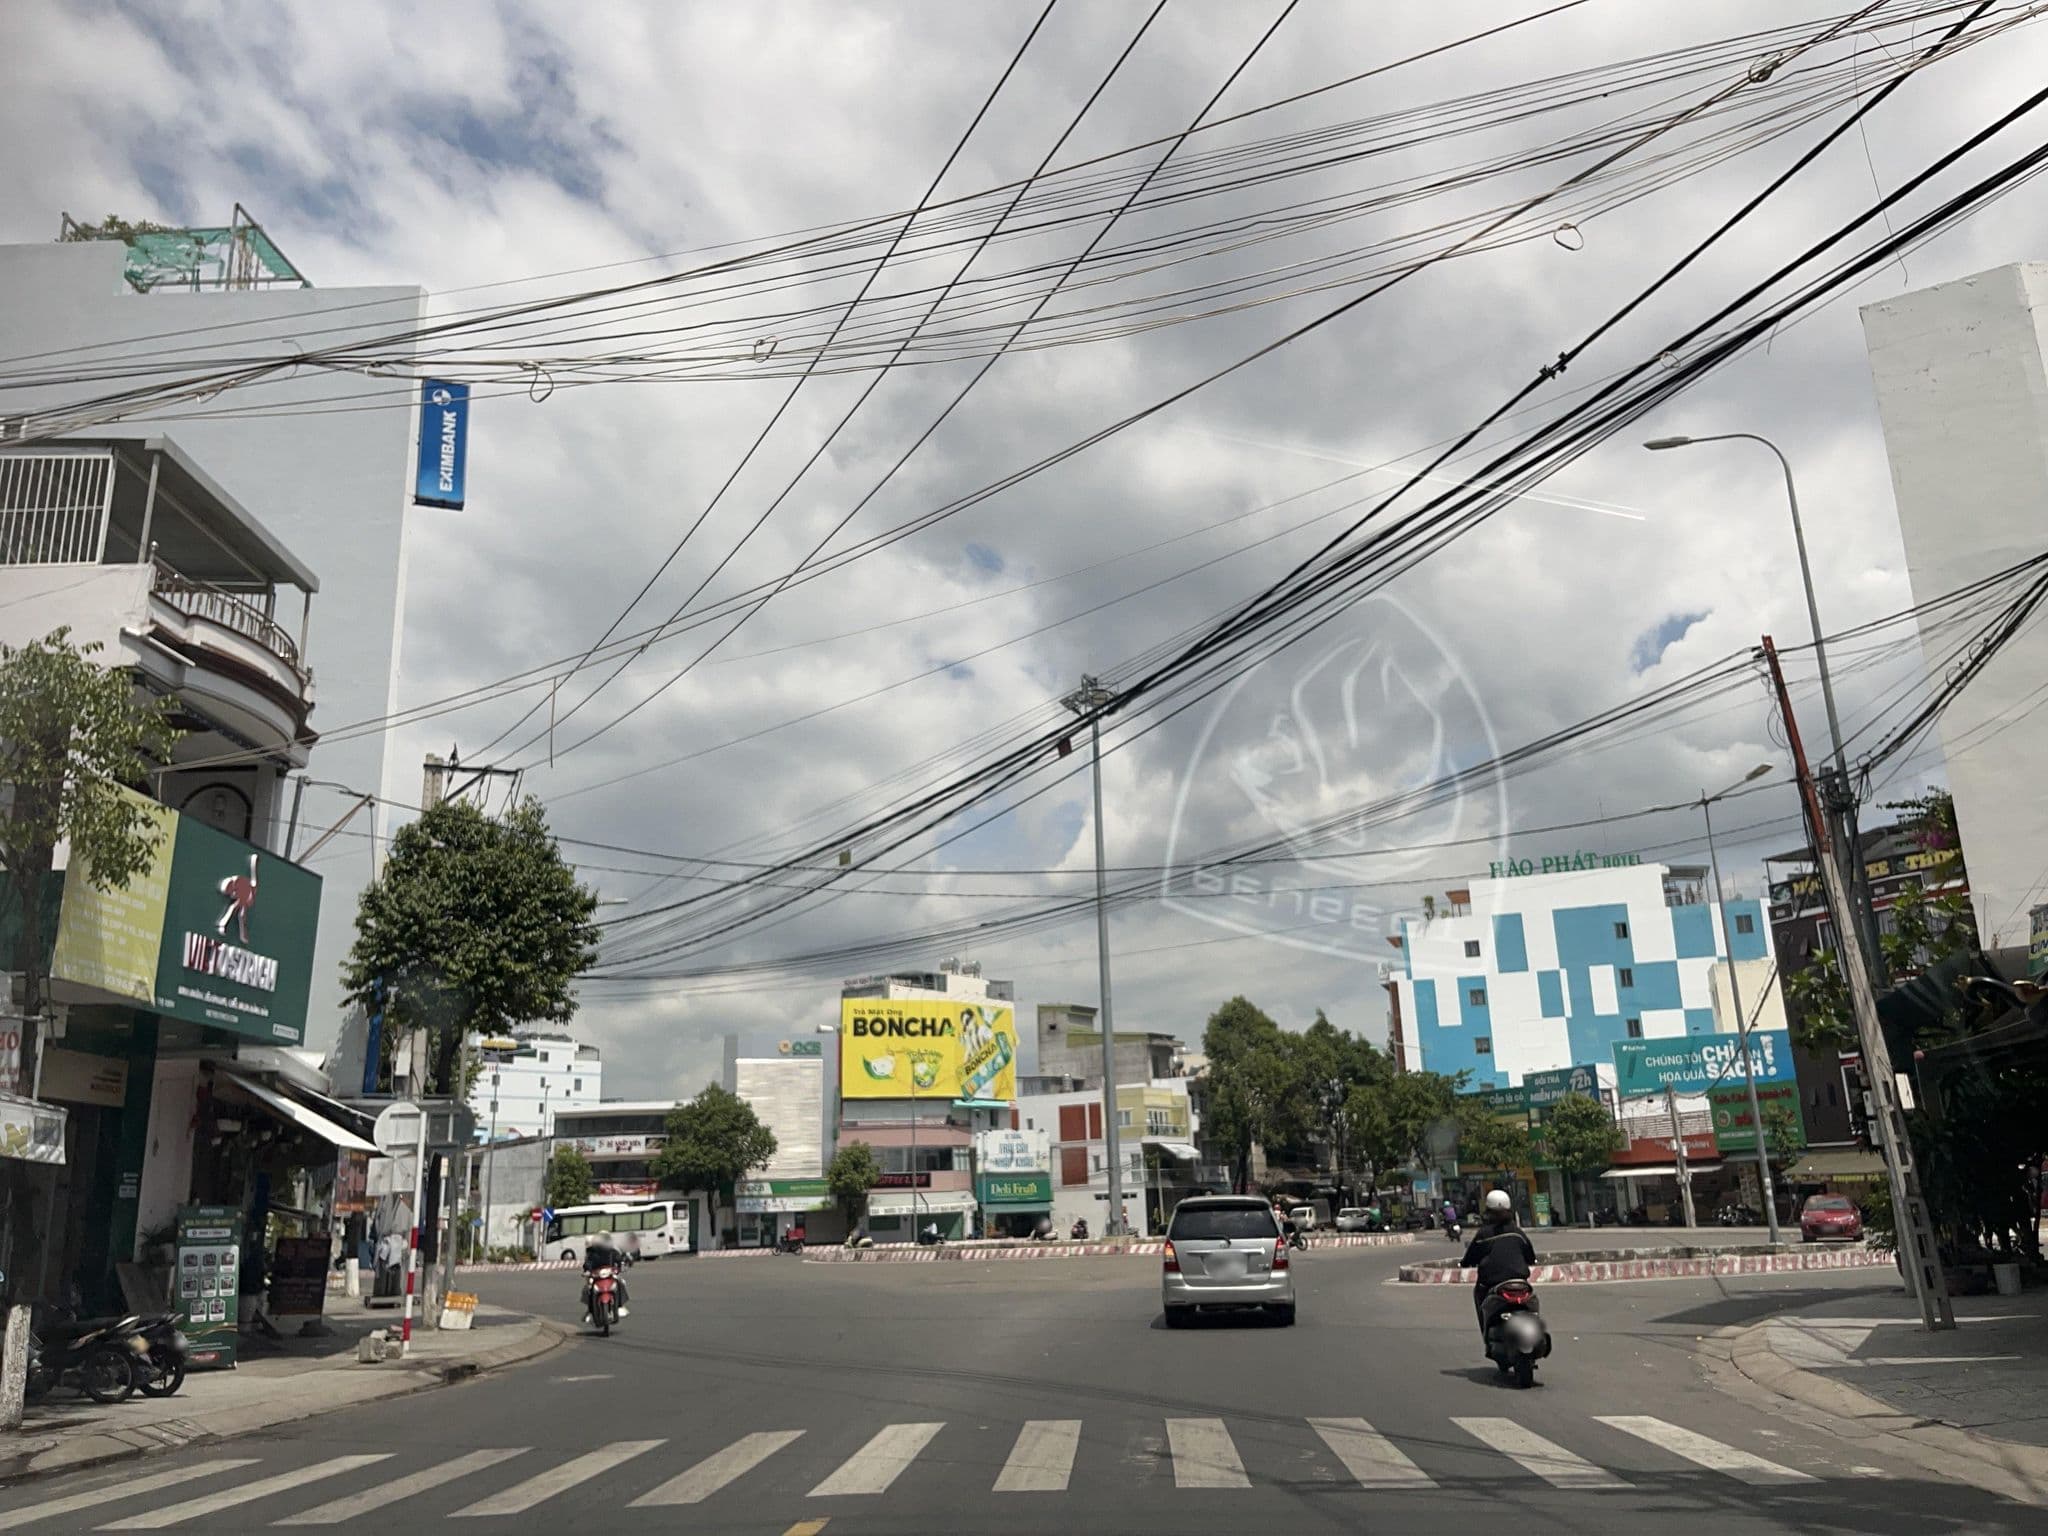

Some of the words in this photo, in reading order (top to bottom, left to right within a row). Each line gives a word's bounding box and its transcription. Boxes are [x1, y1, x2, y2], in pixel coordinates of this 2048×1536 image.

[440, 410, 457, 492] EXIMBANK
[1489, 856, 1534, 879] HÀO
[1541, 850, 1600, 874] PHÁT
[853, 1017, 955, 1038] BONCHA
[964, 1043, 998, 1076] BONCHA
[1645, 1053, 1683, 1067] CHÚNG
[1684, 1052, 1702, 1064] TÔI
[1702, 1039, 1736, 1062] CHỈ
[1658, 1071, 1682, 1083] HOA
[1706, 1059, 1764, 1081] SẠCH
